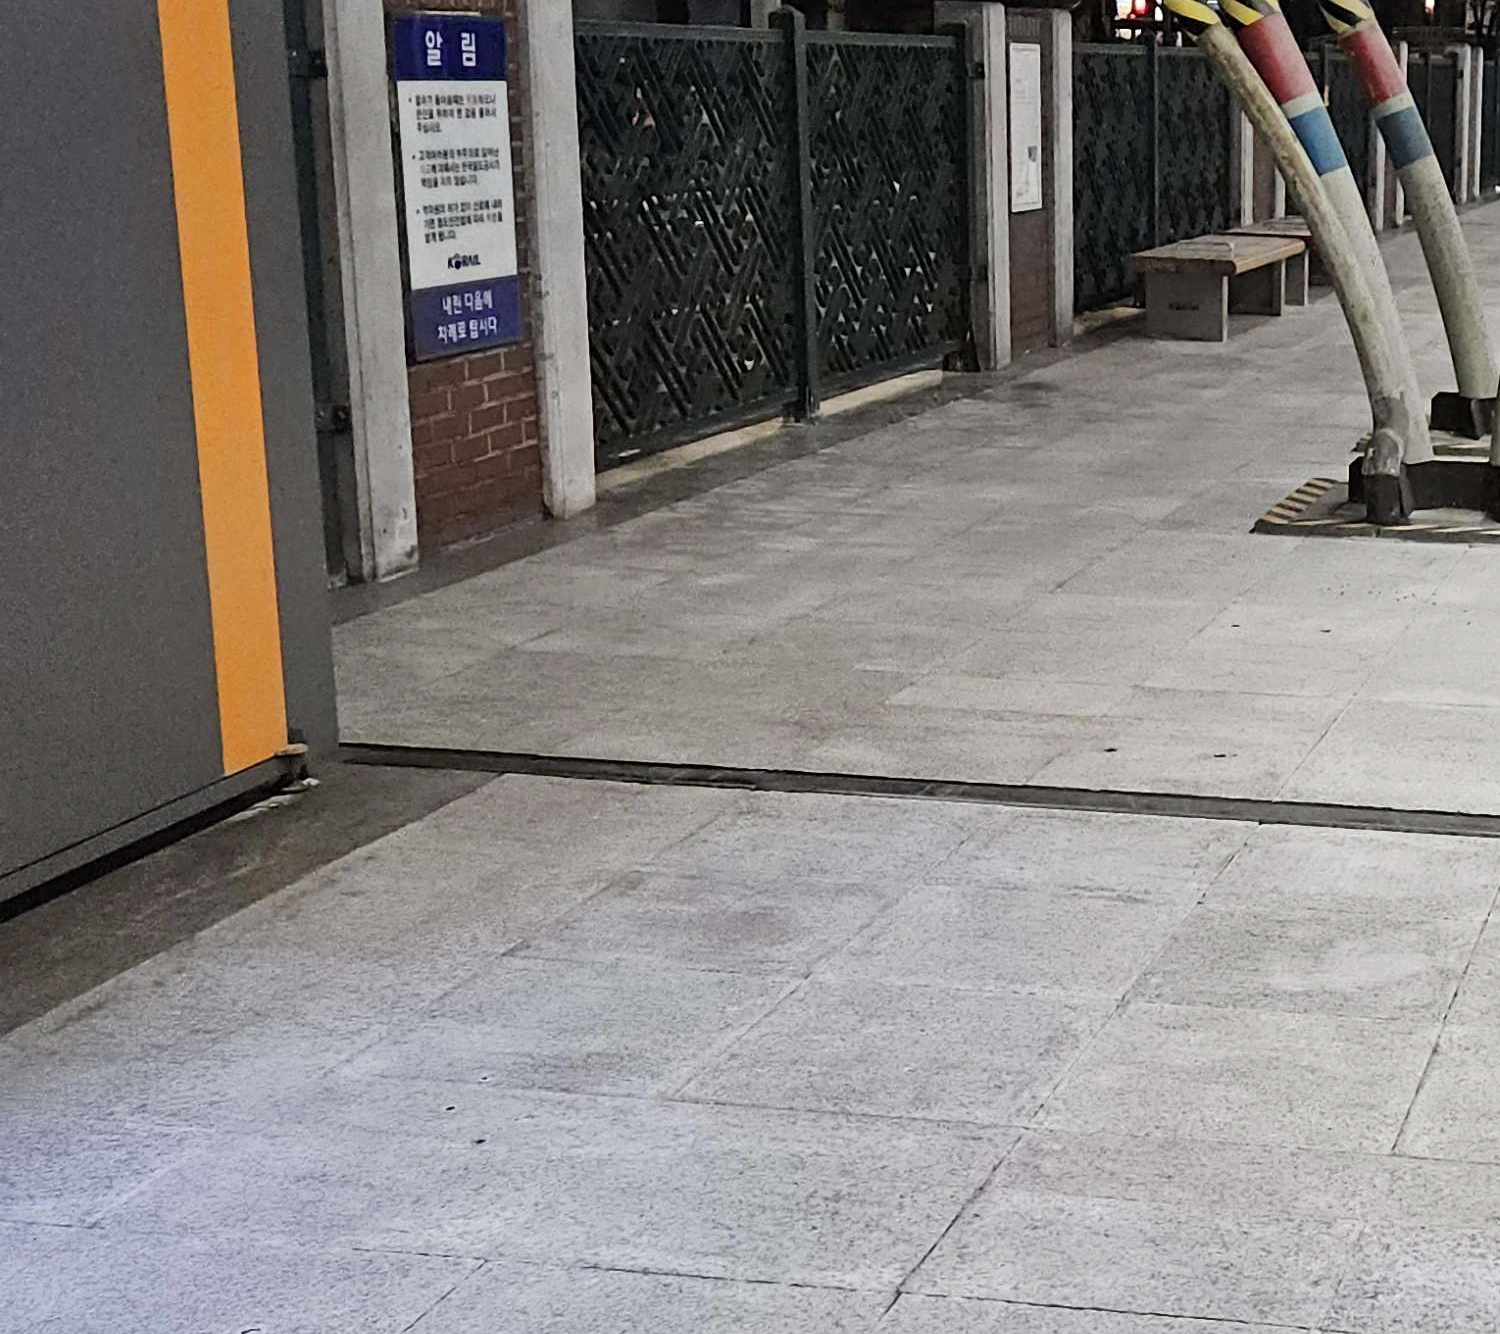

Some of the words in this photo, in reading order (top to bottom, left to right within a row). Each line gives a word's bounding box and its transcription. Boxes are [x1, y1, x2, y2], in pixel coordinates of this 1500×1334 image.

[442, 295, 463, 315] 내린
[464, 290, 493, 311] 다음에
[438, 320, 467, 344] 차례로
